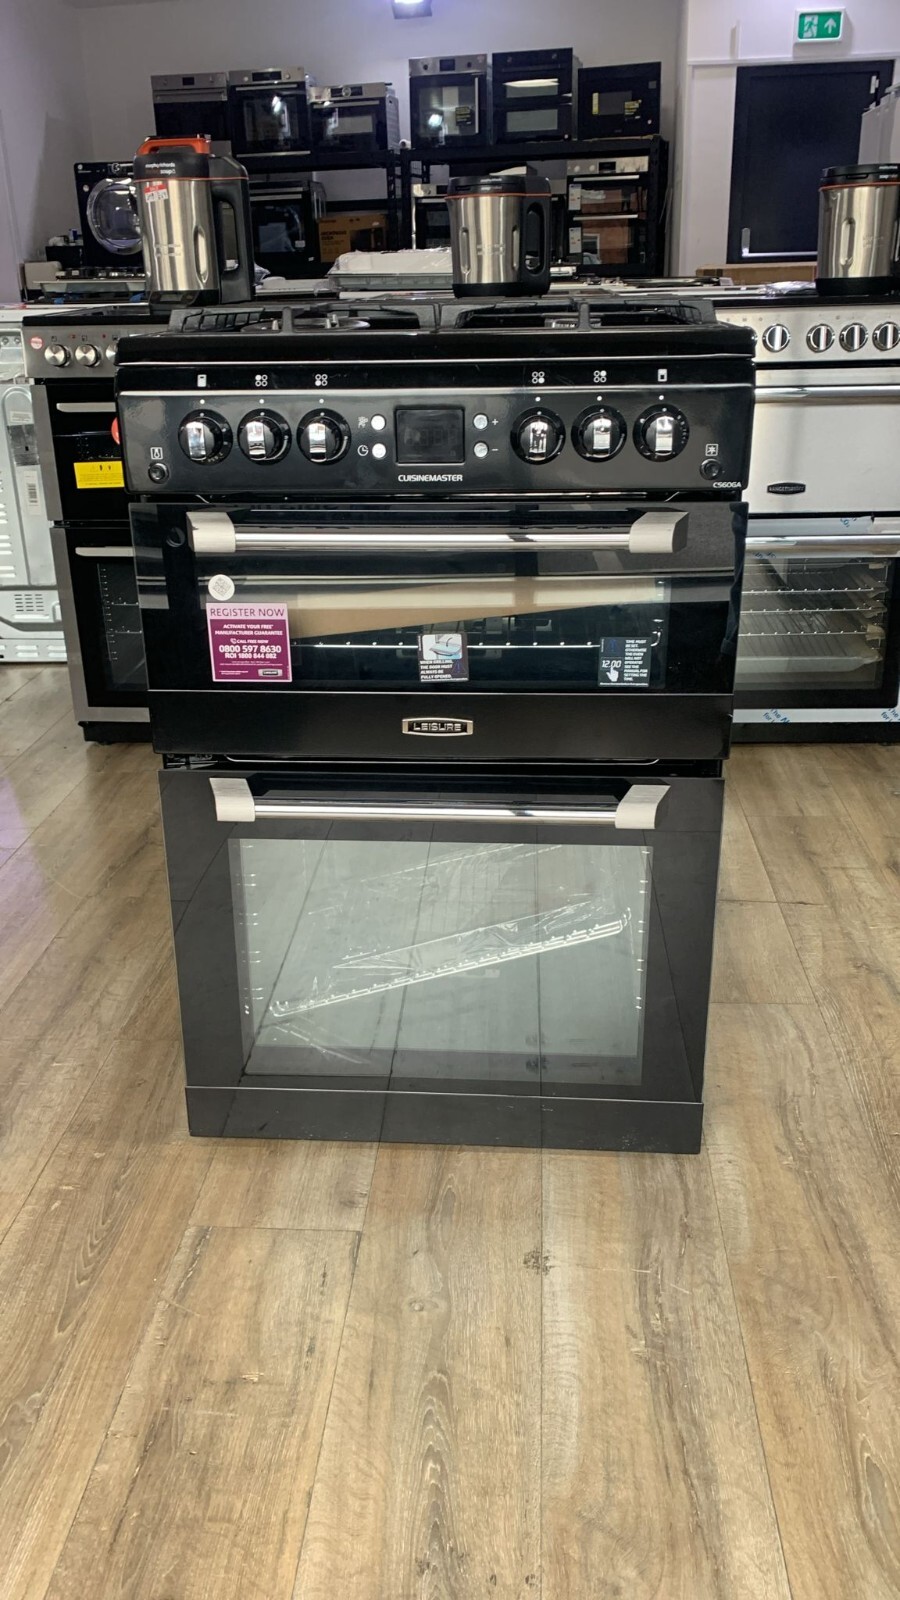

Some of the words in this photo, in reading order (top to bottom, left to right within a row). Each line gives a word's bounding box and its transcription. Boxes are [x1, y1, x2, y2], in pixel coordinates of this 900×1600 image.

[398, 474, 463, 482] CUISINEMASTER
[210, 608, 255, 617] REGISTER
[259, 608, 285, 616] NOW
[219, 645, 240, 653] 0800
[242, 645, 259, 653] 597
[260, 645, 282, 653] 8630
[413, 722, 462, 731] LEISURE
